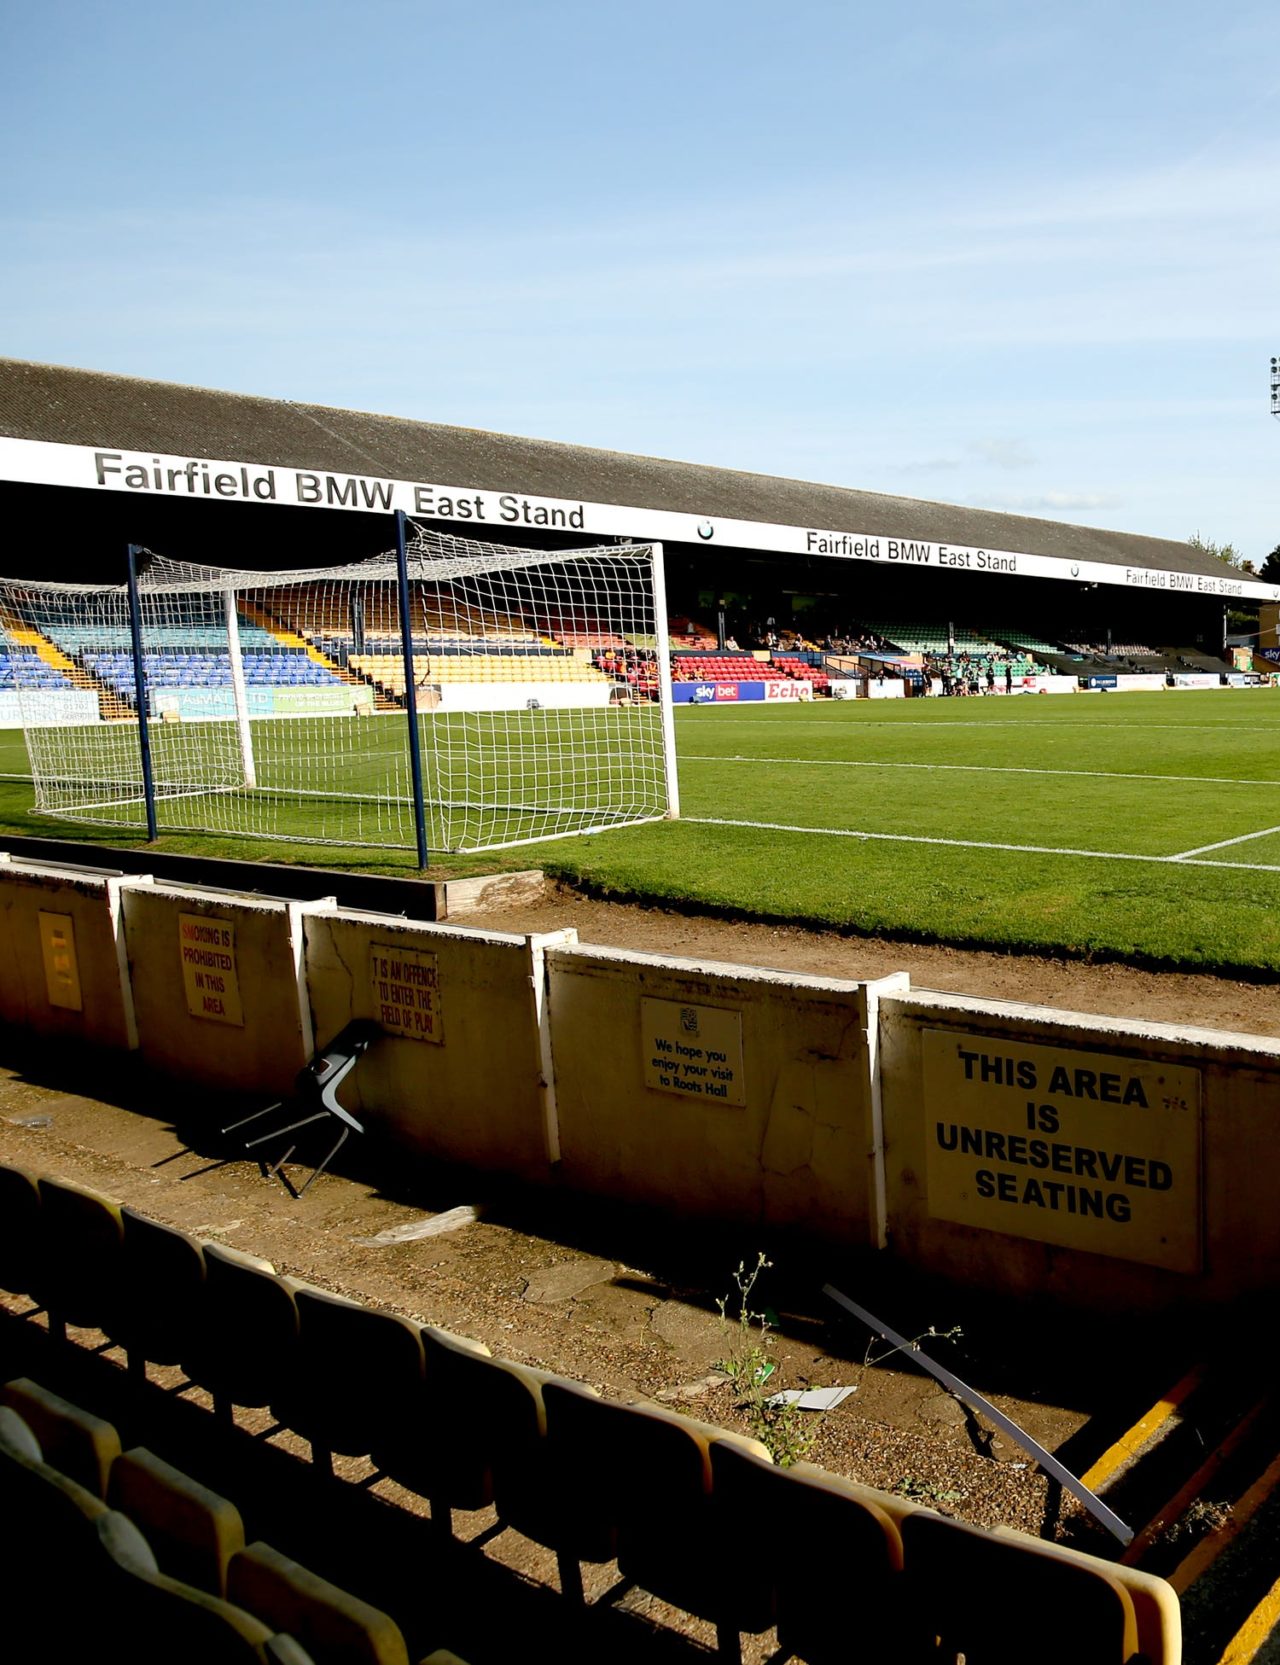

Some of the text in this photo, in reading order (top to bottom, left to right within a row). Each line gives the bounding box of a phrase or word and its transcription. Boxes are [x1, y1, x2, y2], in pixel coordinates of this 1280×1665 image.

[94, 452, 584, 529] Fairfield BMW East Stand
[806, 531, 1017, 571] Fairfield BMW East Stand
[1126, 569, 1242, 595] Fairfield BMW East Stand
[1264, 649, 1280, 660] sky
[695, 684, 736, 699] sky bet
[767, 683, 809, 698] Echo
[182, 923, 231, 948] SMOKING IS
[183, 947, 232, 971] PROHIBITED
[195, 972, 225, 993] IN THIS
[380, 958, 388, 978] IS
[390, 960, 402, 980] AN
[403, 962, 437, 988] OFFENCE
[203, 996, 225, 1016] AREA
[378, 981, 432, 1011] TO ENTER THE
[380, 1004, 433, 1034] FIELD OF PLAY
[655, 1038, 726, 1064] We hope you
[651, 1056, 734, 1081] enjoy your visit
[958, 1050, 1149, 1109] THIS AREA
[659, 1074, 728, 1098] to Roots Hall
[1026, 1102, 1060, 1134] IS
[936, 1122, 1173, 1191] UNRESERVED
[975, 1169, 1131, 1223] SEATING
